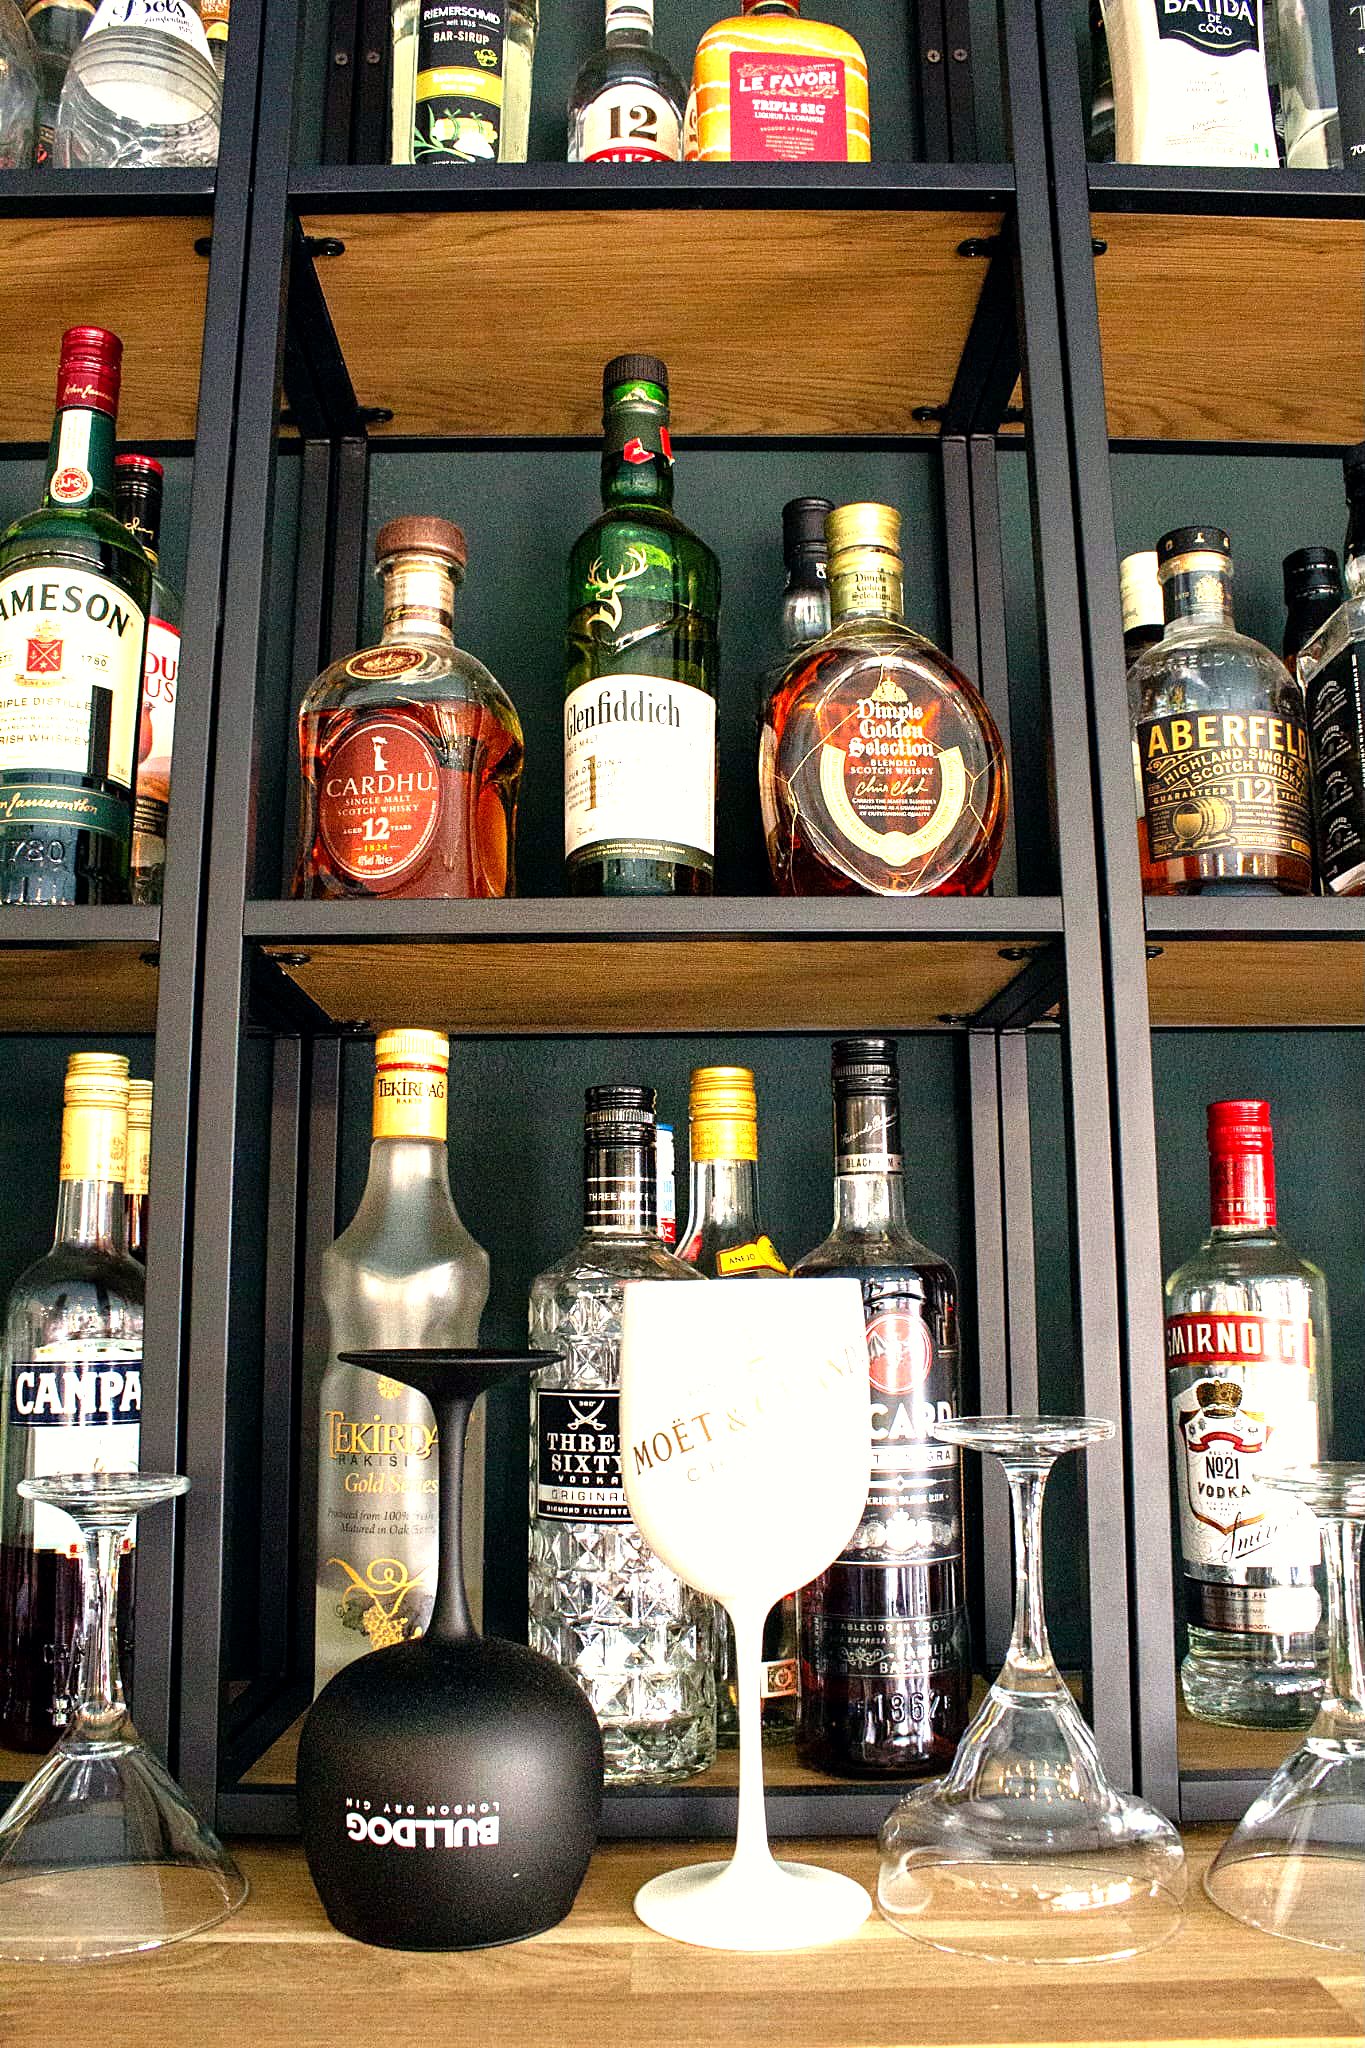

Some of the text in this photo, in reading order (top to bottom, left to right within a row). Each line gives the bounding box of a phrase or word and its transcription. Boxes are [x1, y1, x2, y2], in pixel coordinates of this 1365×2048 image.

[424, 6, 500, 25] RIEMERSCHMID
[1208, 14, 1221, 24] DE
[433, 31, 490, 45] BAR-SIRUP
[740, 71, 837, 92] LE FAVORI
[752, 99, 826, 115] TRIPLE SEC
[608, 105, 657, 142] 12
[855, 573, 887, 584] Dimple
[566, 689, 680, 741] Glenfiddich
[856, 699, 923, 720] Dimple
[859, 719, 923, 739] Golden
[848, 737, 934, 758] Selection
[850, 767, 893, 775] SCOTCH
[870, 759, 917, 767] BLENDED
[1164, 749, 1247, 785] HIGHLAND
[1248, 748, 1296, 771] SINGLE
[1192, 760, 1301, 788] SCOTCH WHISKY
[326, 771, 433, 798] CARDHU
[1154, 787, 1227, 804] GUARANTEED
[1238, 778, 1272, 804] 12
[337, 804, 419, 816] SCOTCH WHISKY
[345, 794, 411, 806] SINGLE MALT
[362, 816, 391, 841] 12
[588, 1192, 618, 1201] THREE
[16, 1371, 142, 1415] CAMPA
[547, 1433, 621, 1453] THRE
[633, 1412, 713, 1476] MOËT
[551, 1453, 623, 1474] SIXTY
[344, 1472, 439, 1494] Gold Seies
[558, 1475, 619, 1485] VODKA
[1197, 1481, 1251, 1499] VODKA
[551, 1489, 627, 1502] ORIGINAL
[546, 1505, 580, 1514] DIAMOND
[346, 1797, 500, 1816] LONDON DRY GIN
[346, 1812, 500, 1849] BULLDOG
